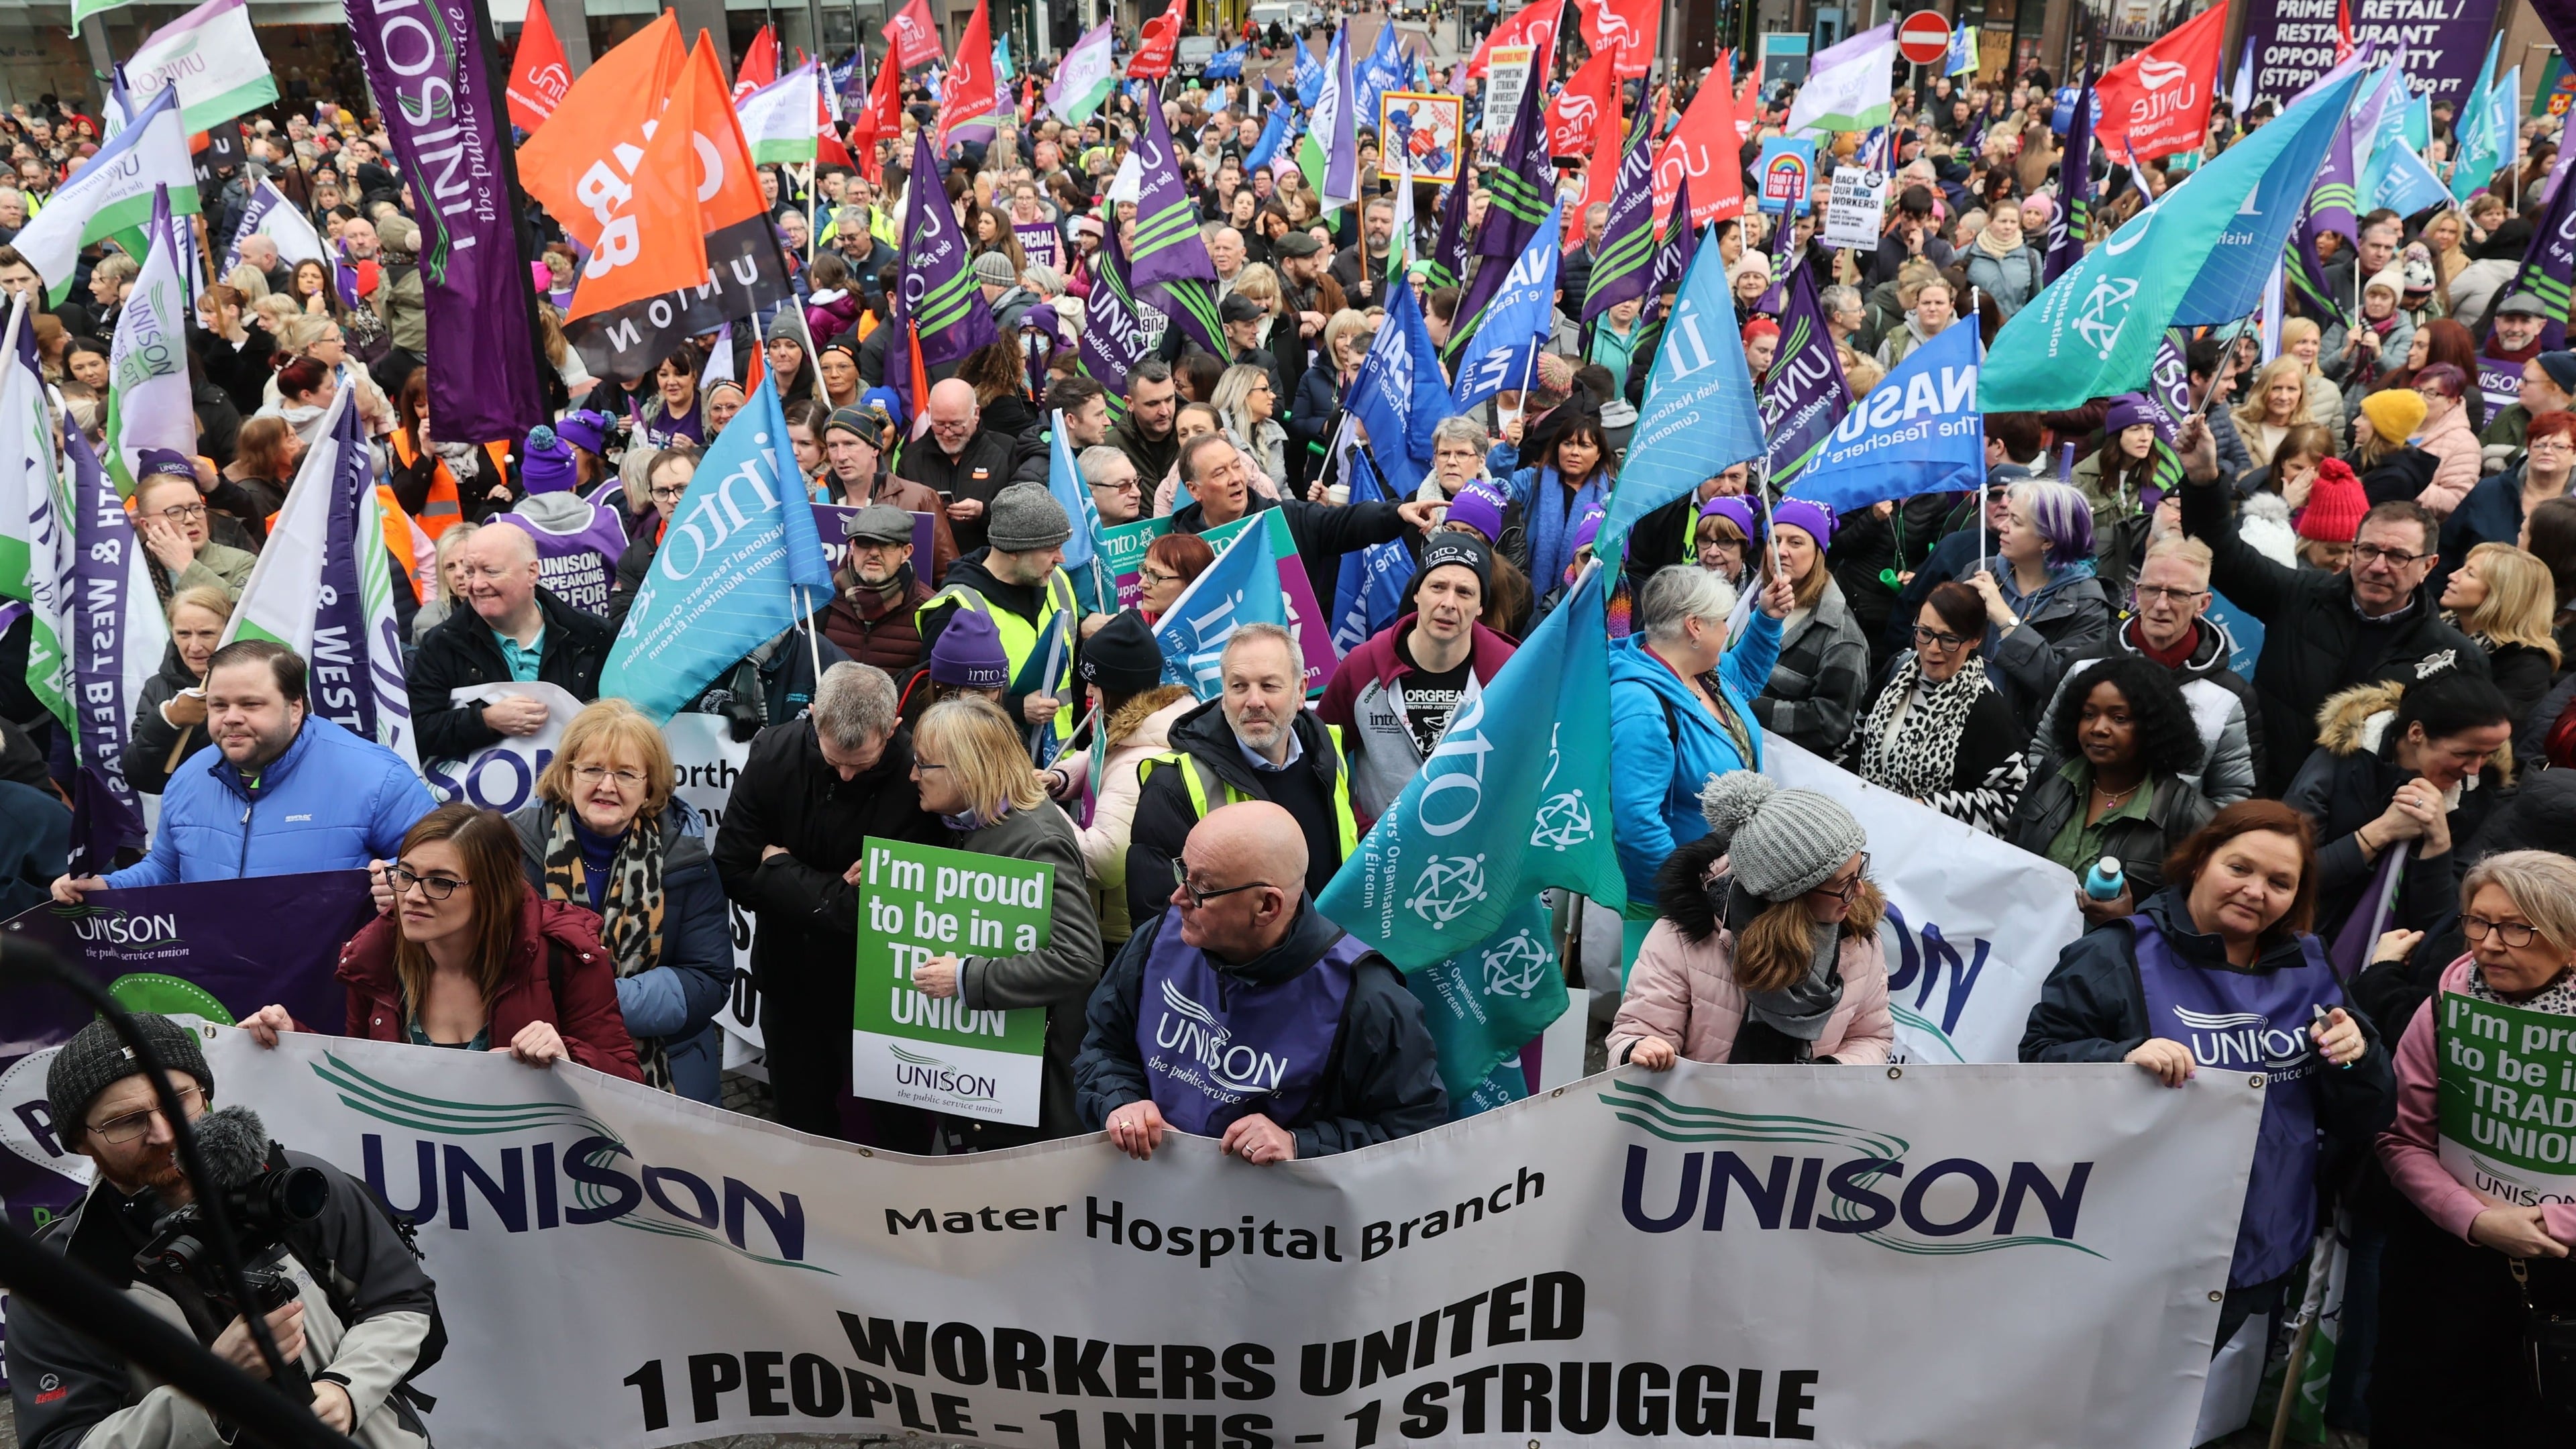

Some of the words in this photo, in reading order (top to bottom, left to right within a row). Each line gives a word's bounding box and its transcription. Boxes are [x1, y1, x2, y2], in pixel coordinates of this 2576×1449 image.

[2275, 0, 2337, 18] PRIME
[2361, 0, 2449, 19] RETAIL
[449, 7, 471, 95] service
[2264, 46, 2443, 68] OPPORUNITY
[528, 65, 570, 101] Unit
[1493, 69, 1523, 78] SUPPORTING
[1496, 80, 1517, 90] STRIKING
[2438, 78, 2462, 92] FT
[1490, 104, 1499, 113] AND
[1500, 103, 1519, 114] COLLEG
[1493, 92, 1519, 102] UNIVERSITY
[372, 0, 477, 251] UNISO
[460, 103, 492, 180] public
[1768, 184, 1784, 196] FOR
[1770, 173, 1788, 184] FAIR
[1833, 186, 1851, 196] OUR
[1853, 187, 1872, 198] NHS
[1835, 175, 1858, 185] BACK
[474, 186, 496, 222] the
[1832, 197, 1878, 210] WORKERS!
[1014, 230, 1055, 248] FICIAL
[128, 294, 176, 377] UNISON
[1088, 279, 1146, 363] UNIS
[1142, 317, 1165, 332] PUB
[1084, 329, 1115, 362] public
[1459, 484, 1508, 513] UNISO
[1108, 533, 1137, 556] nto
[1426, 547, 1458, 566] into
[539, 551, 603, 577] UNISON
[540, 568, 605, 590] SPEAKING
[571, 583, 608, 607] FOR
[313, 625, 364, 733] WEST
[967, 667, 1000, 681] into
[1405, 690, 1464, 702] ORGREA
[868, 847, 924, 891] I'm
[934, 866, 1045, 910] proud
[1363, 851, 1382, 909] Éireann
[1381, 847, 1401, 939] Organisation
[868, 896, 904, 932] to
[914, 902, 958, 941] be
[970, 908, 1003, 947] in
[1016, 926, 1037, 953] a
[86, 946, 97, 958] the
[120, 949, 155, 961] service
[158, 947, 190, 959] union
[891, 987, 1006, 1038] UNION
[1436, 981, 1465, 1020] Éireann
[1450, 966, 1488, 1026] Organisation
[2447, 999, 2510, 1042] I'm
[1156, 1012, 1289, 1090] UNISON
[2449, 1036, 2485, 1072] to
[2496, 1049, 2548, 1087] be
[896, 1063, 996, 1099] UNISON
[1148, 1055, 1168, 1072] the
[1167, 1065, 1206, 1089] public
[2266, 1068, 2302, 1085] rvice
[897, 1089, 911, 1099] the
[913, 1093, 940, 1104] public
[942, 1099, 973, 1111] service
[975, 1104, 1003, 1115] union
[2469, 1076, 2576, 1128] TRAD
[360, 1133, 806, 1261] UNISON
[1621, 1144, 2094, 1240] UNISON
[885, 1205, 1068, 1236] Mater
[1085, 1195, 1343, 1269] Hospital
[1359, 1166, 1545, 1263] Branch
[835, 1309, 1276, 1402] WORKERS
[1299, 1270, 1585, 1397] UNITED
[623, 1360, 669, 1432] 1
[688, 1351, 975, 1437] PEOPLE
[1039, 1409, 1081, 1449] 1
[1103, 1413, 1274, 1449] NHS
[1342, 1400, 1382, 1448] 1
[1400, 1361, 1819, 1442] STRUGGLE
